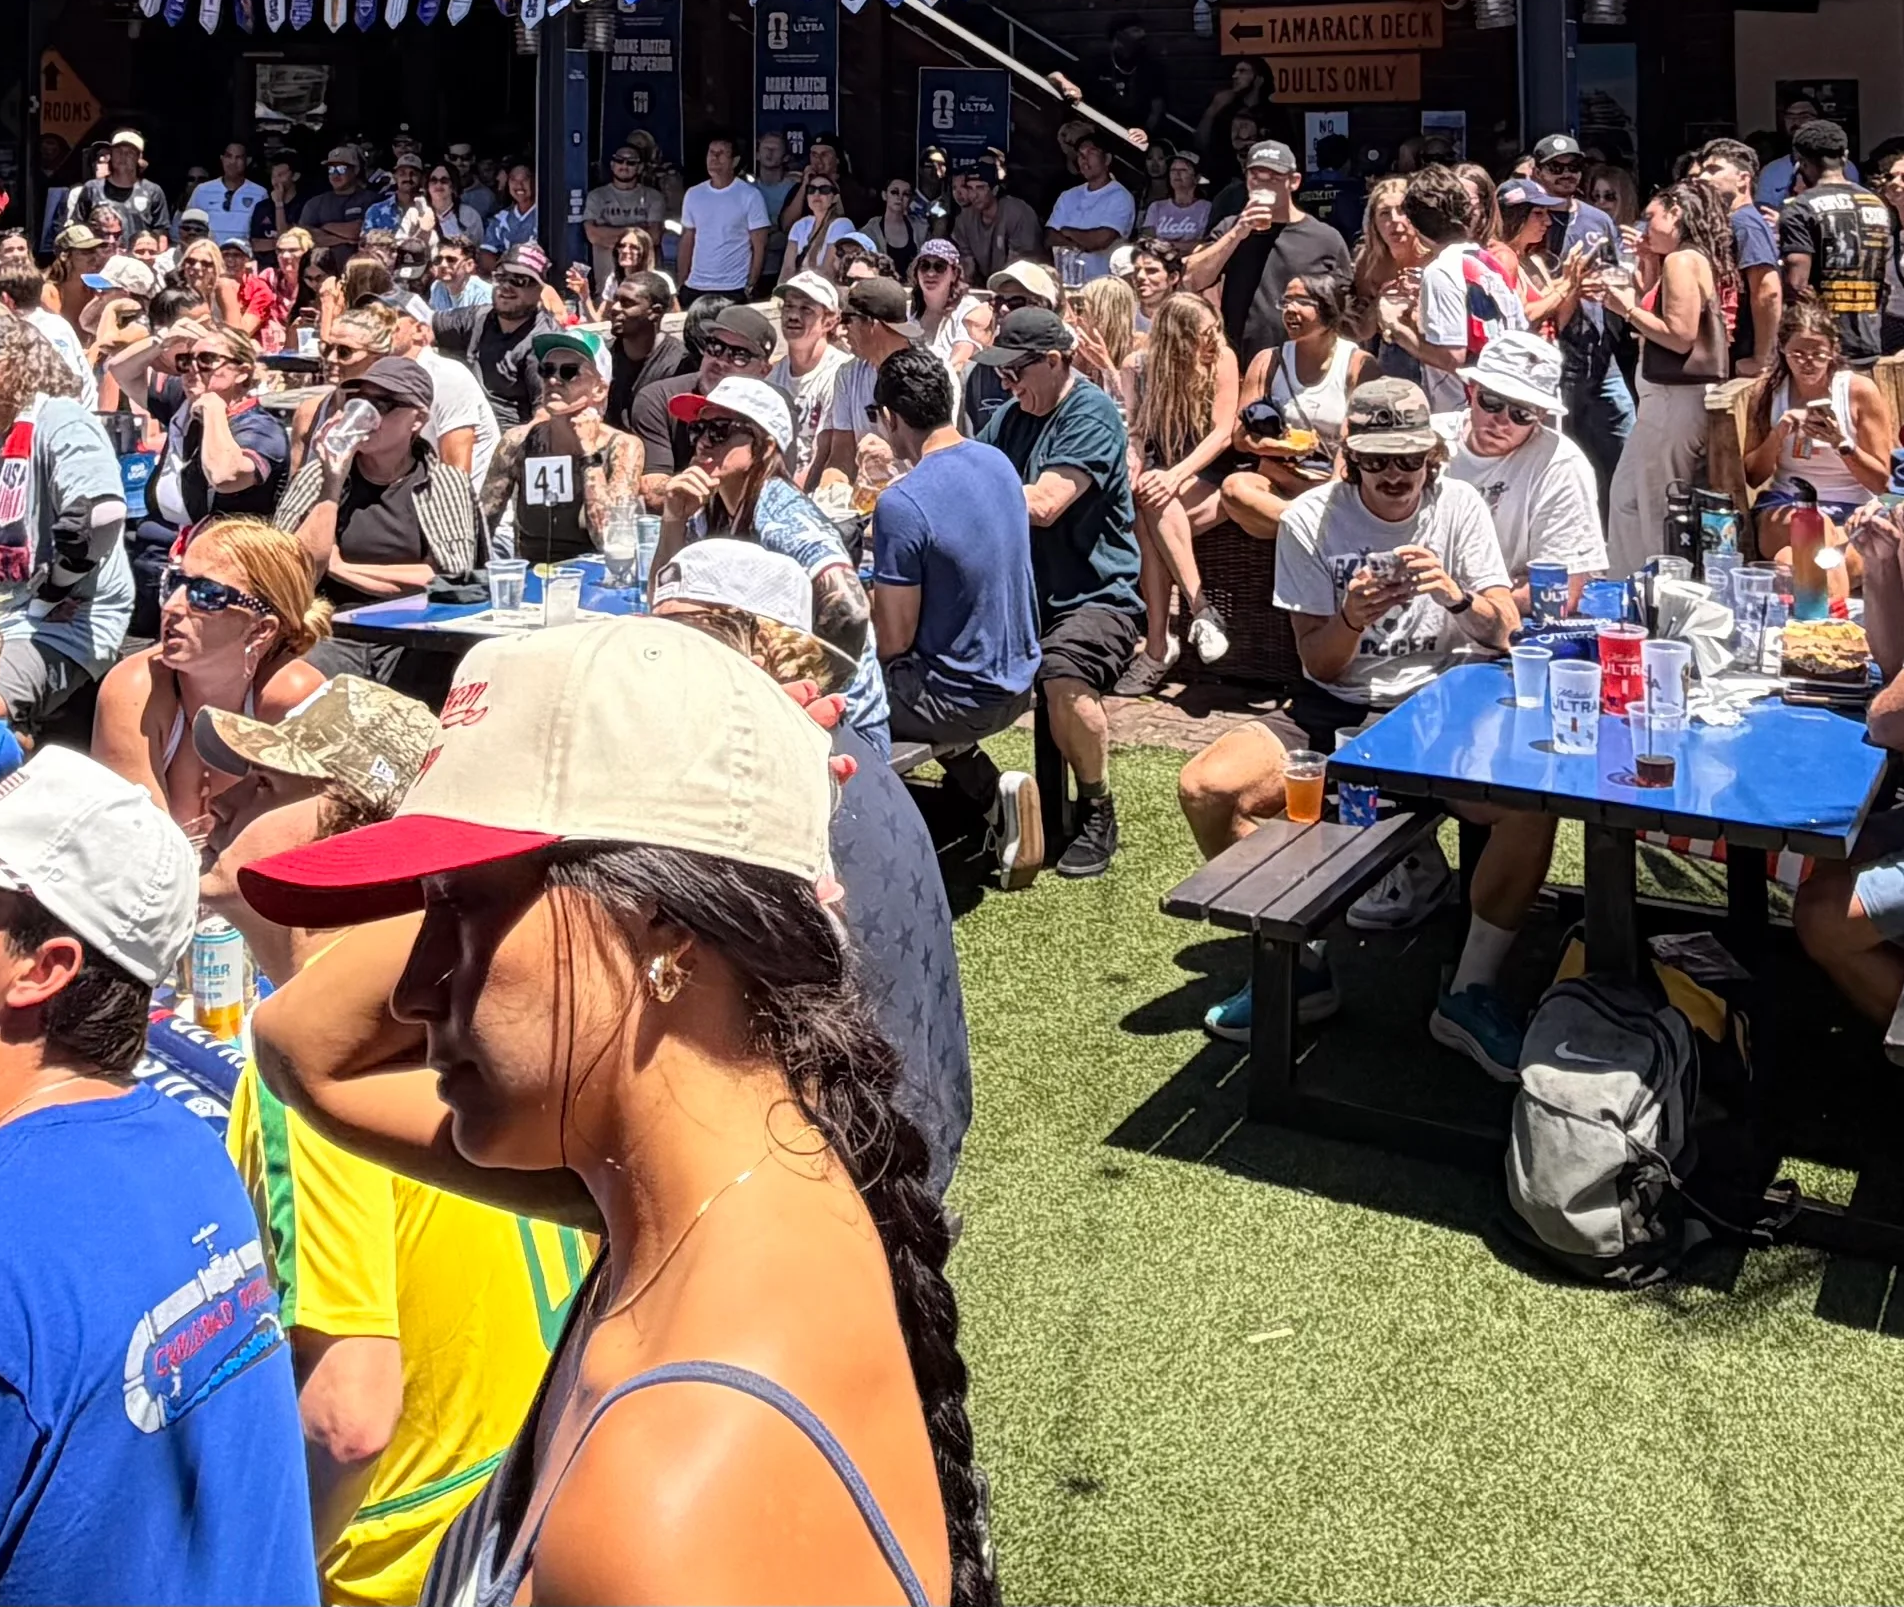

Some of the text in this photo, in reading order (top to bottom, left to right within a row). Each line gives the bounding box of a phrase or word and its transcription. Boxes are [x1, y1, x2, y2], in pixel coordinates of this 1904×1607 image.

[1268, 11, 1434, 44] TAMARACK DECK
[1277, 65, 1396, 94] DULTS ONLY
[44, 101, 91, 122] ROOMS
[783, 94, 830, 111] SUPERIOR
[959, 102, 995, 114] ULTRA
[1156, 216, 1197, 234] Ucla
[534, 464, 565, 495] 41
